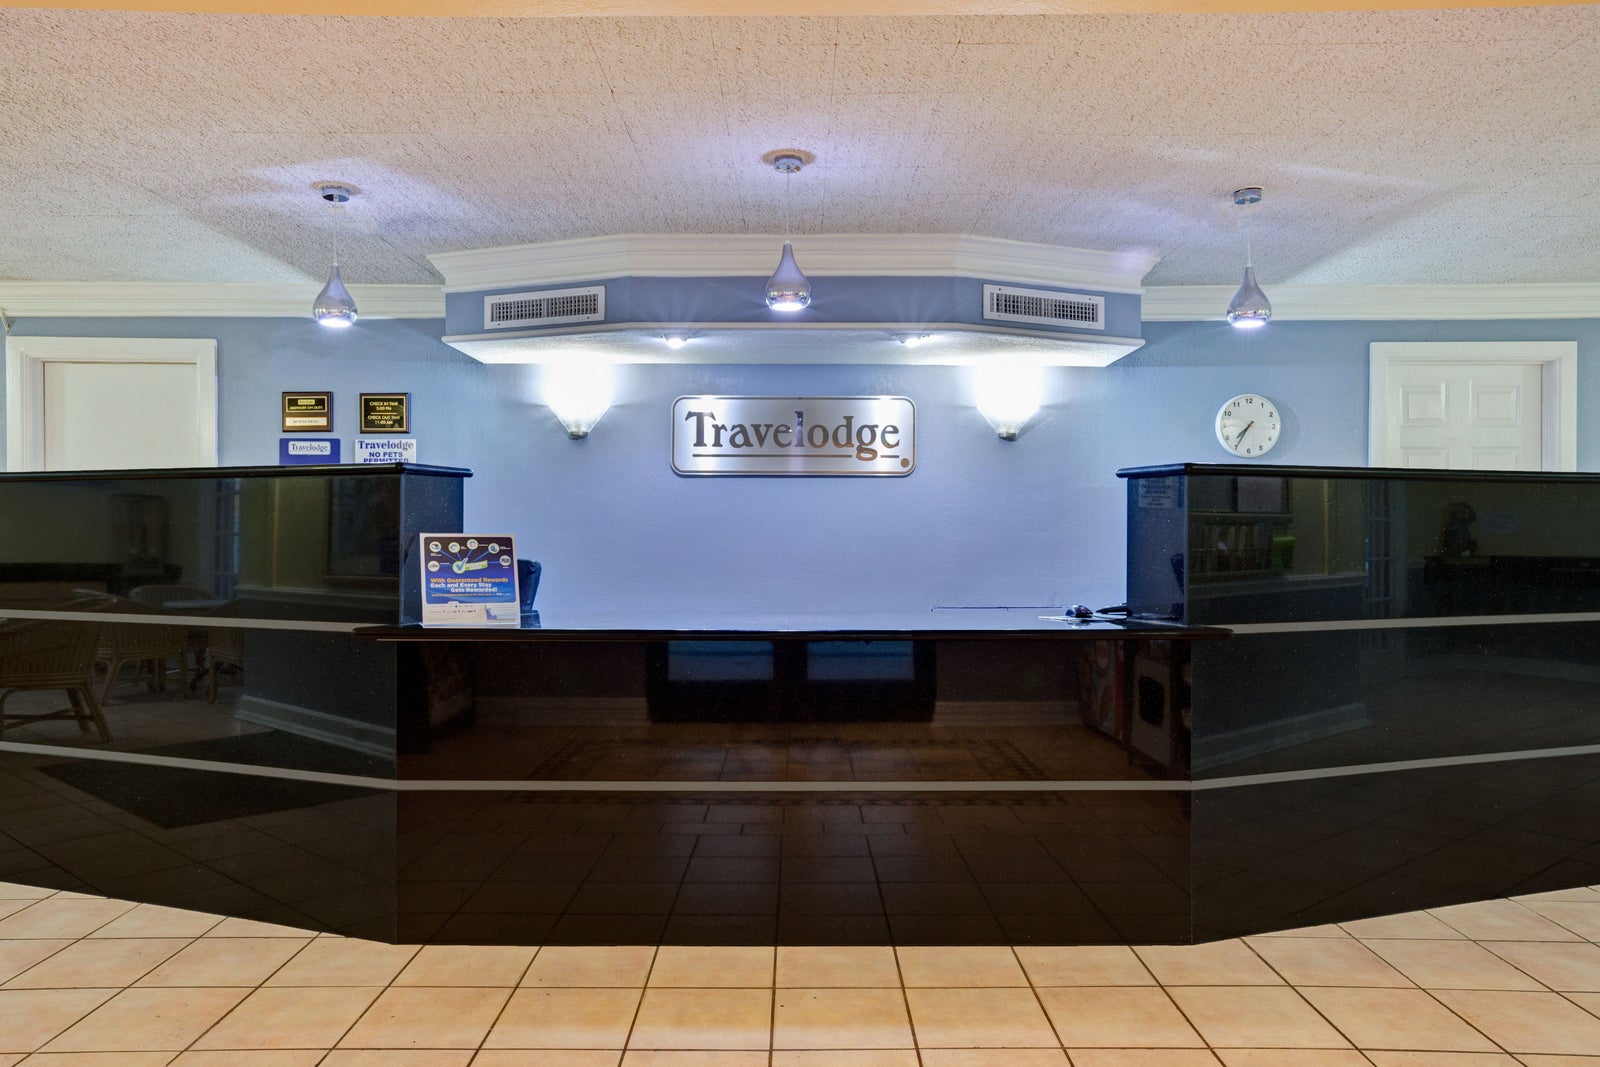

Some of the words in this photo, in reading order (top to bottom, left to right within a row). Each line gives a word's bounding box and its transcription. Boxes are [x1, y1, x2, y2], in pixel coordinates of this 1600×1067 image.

[685, 411, 900, 461] Travelodge
[290, 443, 329, 453] Travelodge
[358, 440, 415, 451] Travelodge
